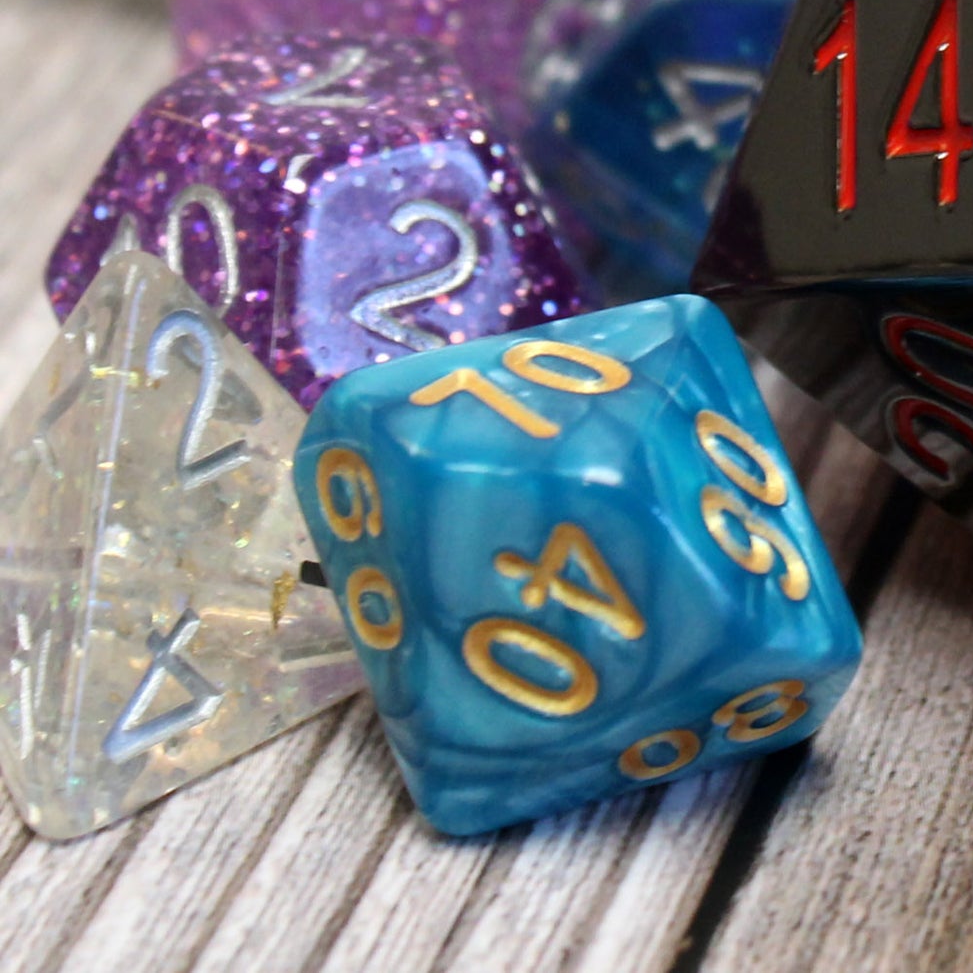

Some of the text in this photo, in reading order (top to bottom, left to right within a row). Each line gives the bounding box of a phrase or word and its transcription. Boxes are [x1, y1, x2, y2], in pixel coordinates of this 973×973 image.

[102, 182, 240, 319] 0
[349, 198, 480, 352] 2
[145, 308, 251, 490] 2
[102, 606, 224, 765] 4
[461, 521, 647, 717] 40
